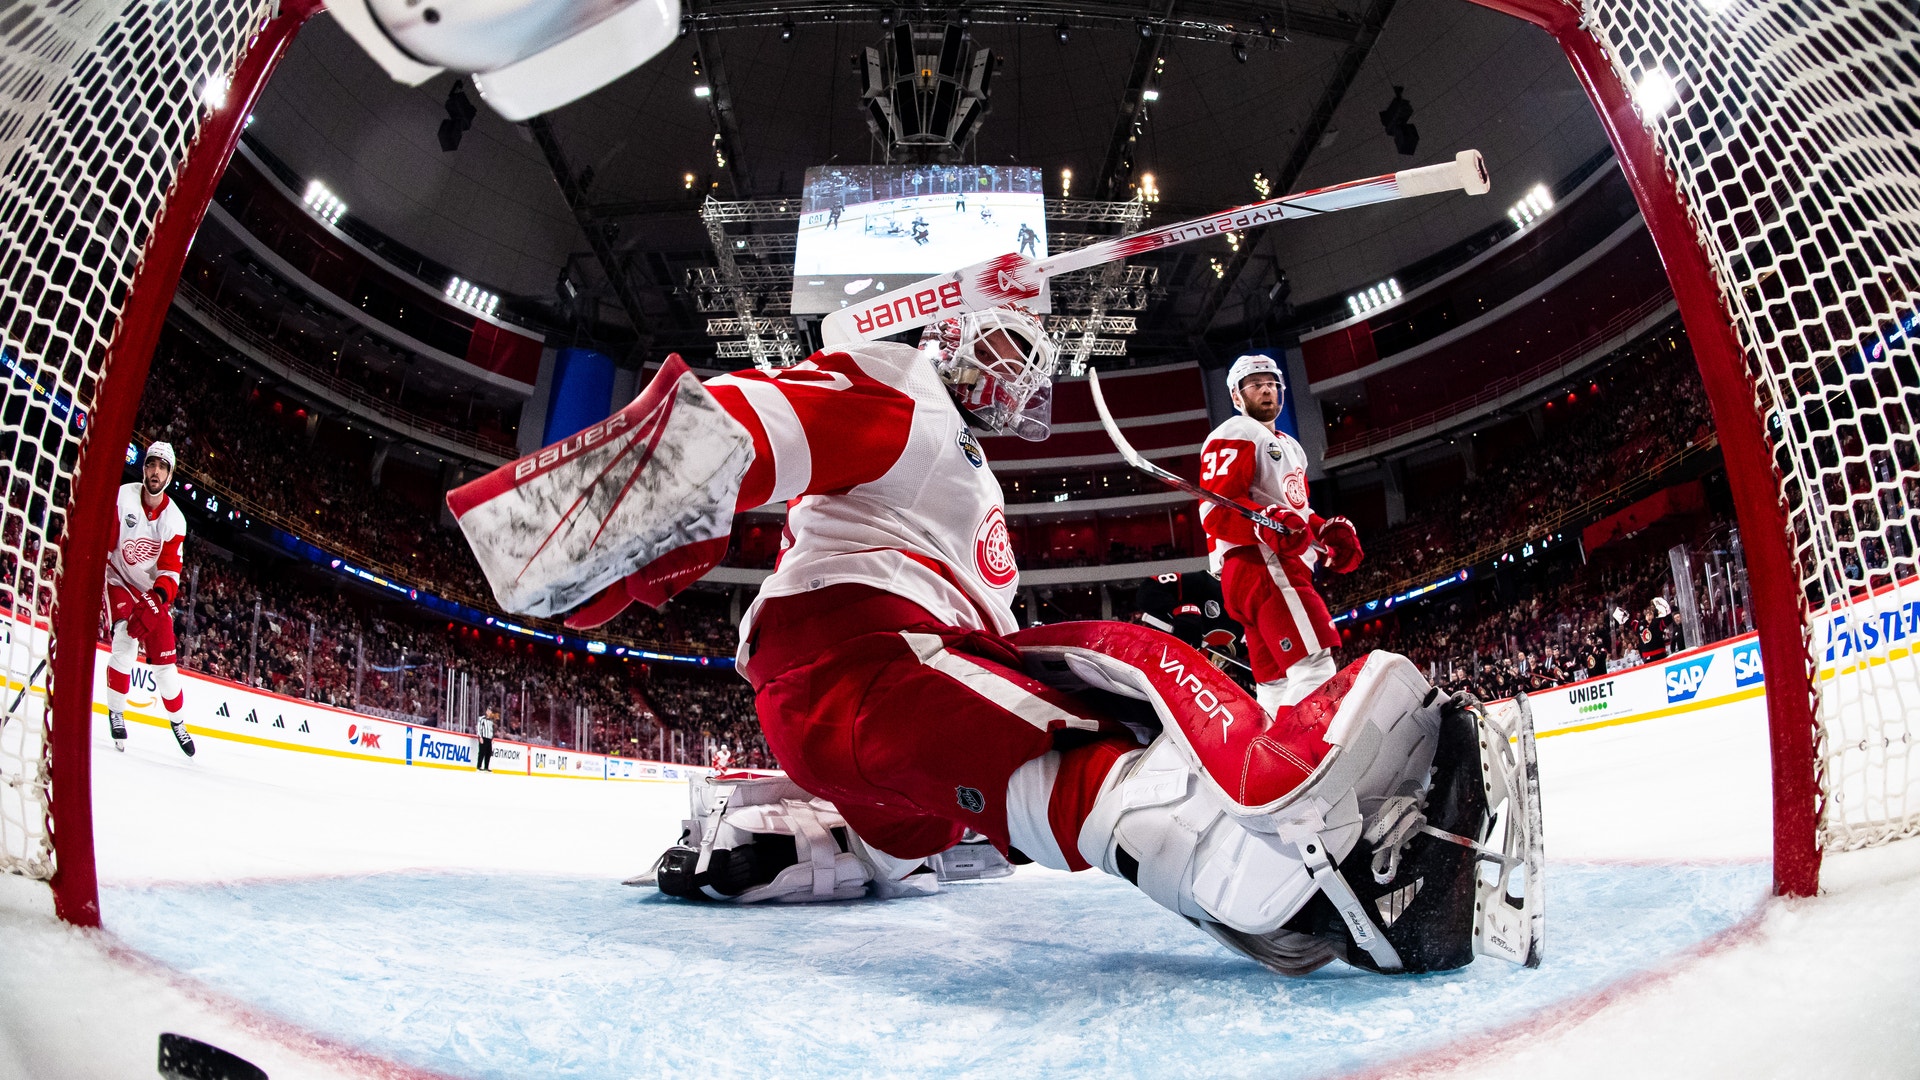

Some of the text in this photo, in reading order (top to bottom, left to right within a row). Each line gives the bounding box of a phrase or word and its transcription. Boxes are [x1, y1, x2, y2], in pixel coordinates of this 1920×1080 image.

[852, 280, 963, 334] BAUER
[515, 413, 628, 481] BAUER
[1202, 448, 1238, 481] 37
[1250, 511, 1287, 534] BAUE
[131, 667, 157, 692] WS
[1666, 665, 1704, 698] SAP
[1734, 652, 1764, 681] SA
[1159, 644, 1235, 744] VAPOR
[1569, 680, 1615, 705] UNIBET
[418, 733, 472, 763] FASTENAL
